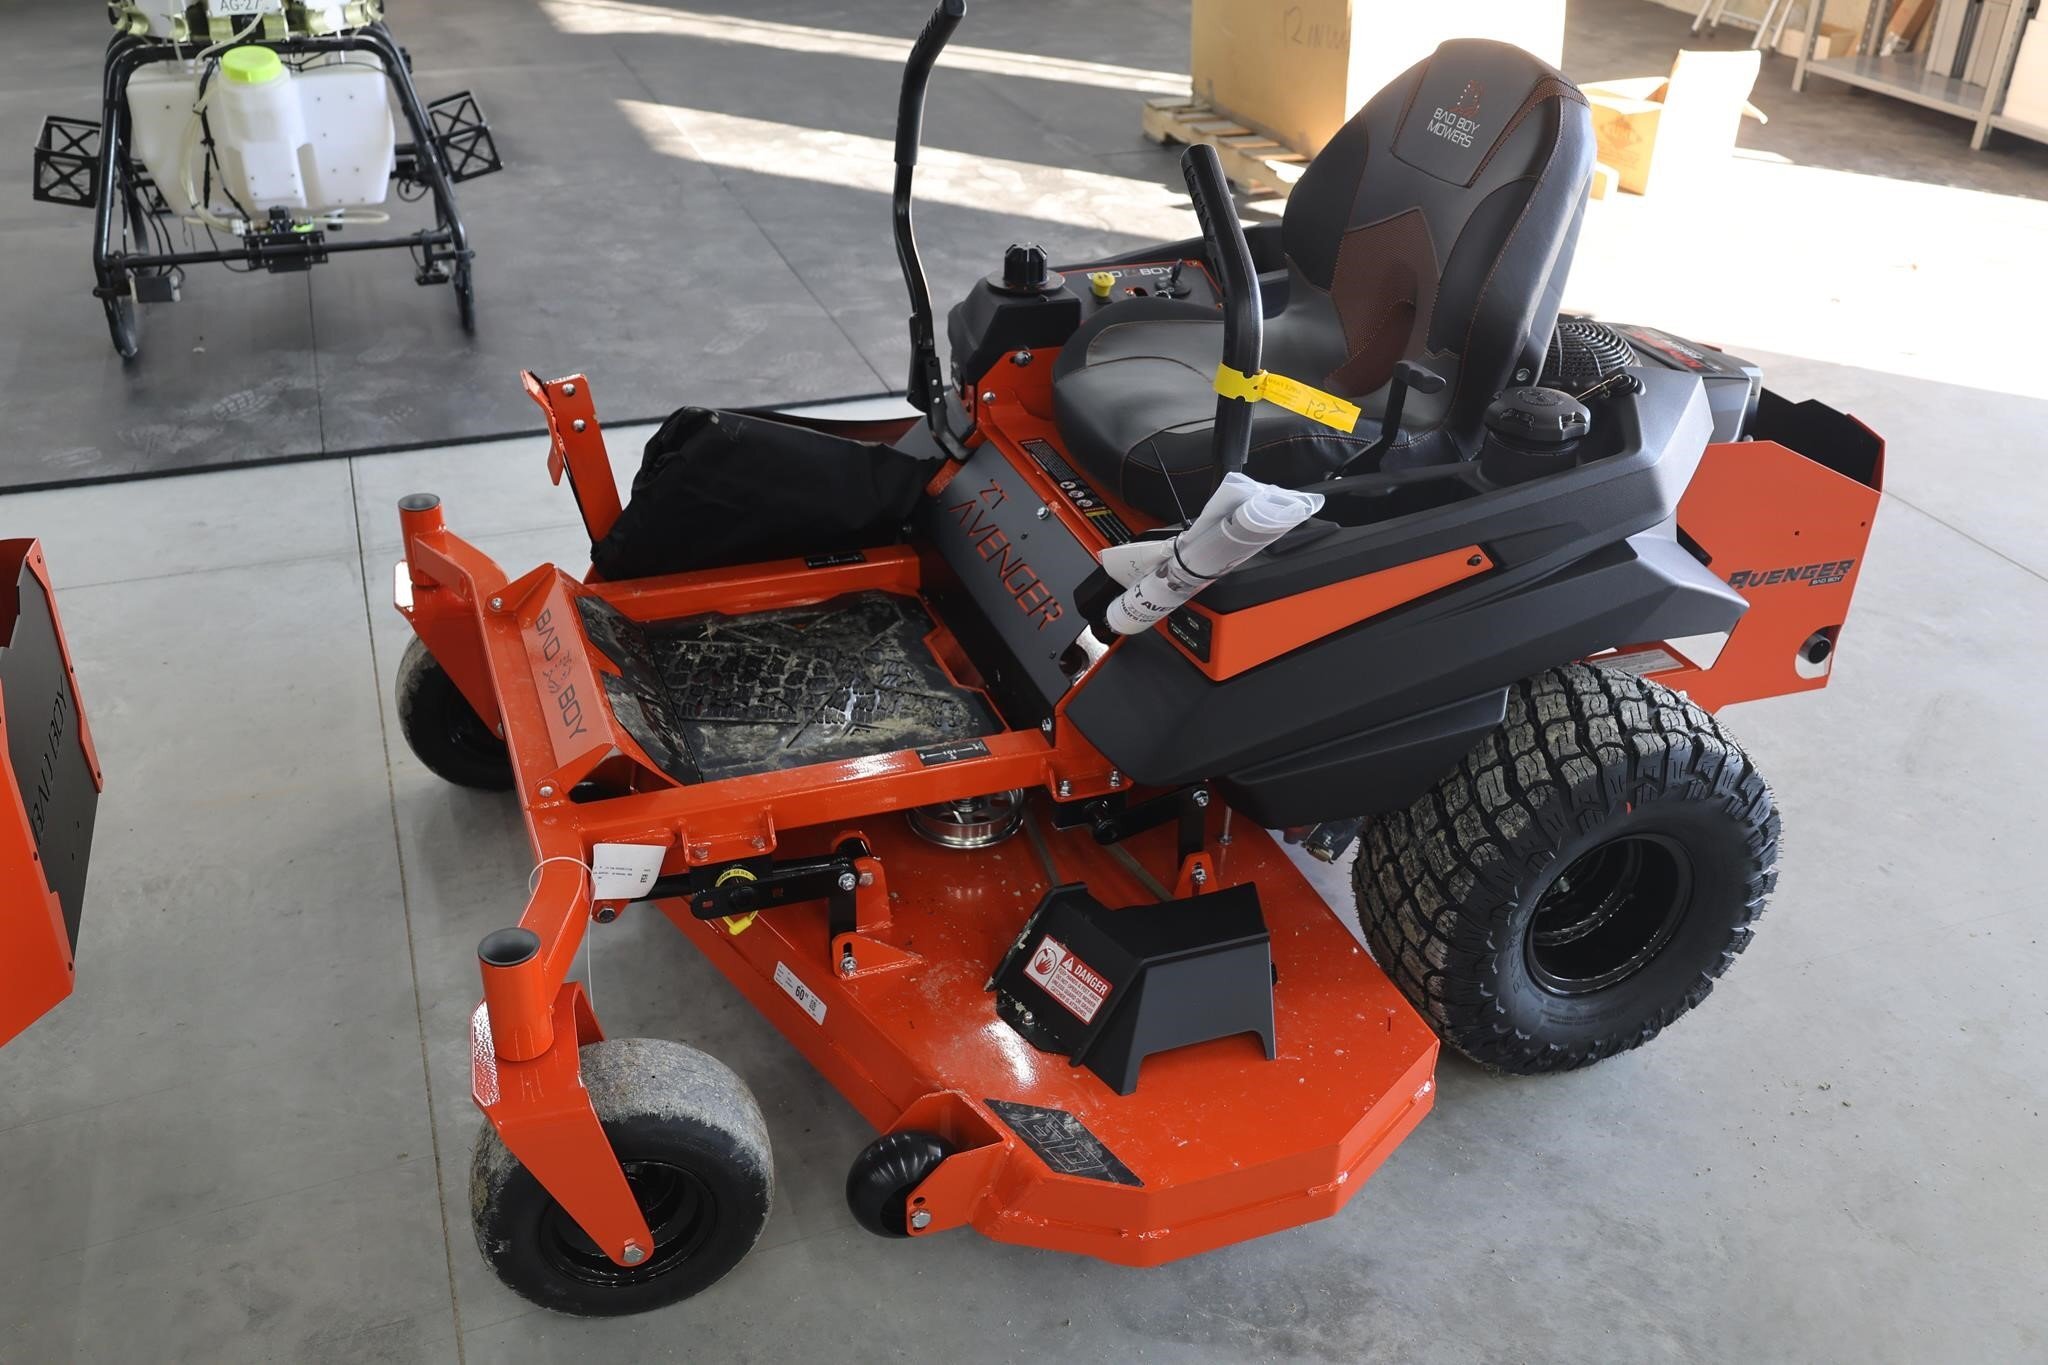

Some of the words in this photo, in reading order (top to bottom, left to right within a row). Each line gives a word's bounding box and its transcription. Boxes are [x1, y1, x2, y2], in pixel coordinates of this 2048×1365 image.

[1426, 119, 1474, 148] MOWERS
[1433, 107, 1456, 125] BAD
[1456, 117, 1481, 134] BOY
[1139, 266, 1172, 276] BOY
[979, 478, 1009, 510] ZT
[947, 499, 1064, 632] AVENGER
[536, 608, 560, 662] BAD
[558, 683, 587, 740] BOY
[1051, 986, 1066, 999] CATCHER
[1066, 975, 1078, 986] HANDS
[1081, 986, 1090, 994] FEET
[1068, 983, 1083, 997] OPERATE
[1073, 964, 1108, 996] DANGER
[1064, 989, 1076, 1000] GUARD
